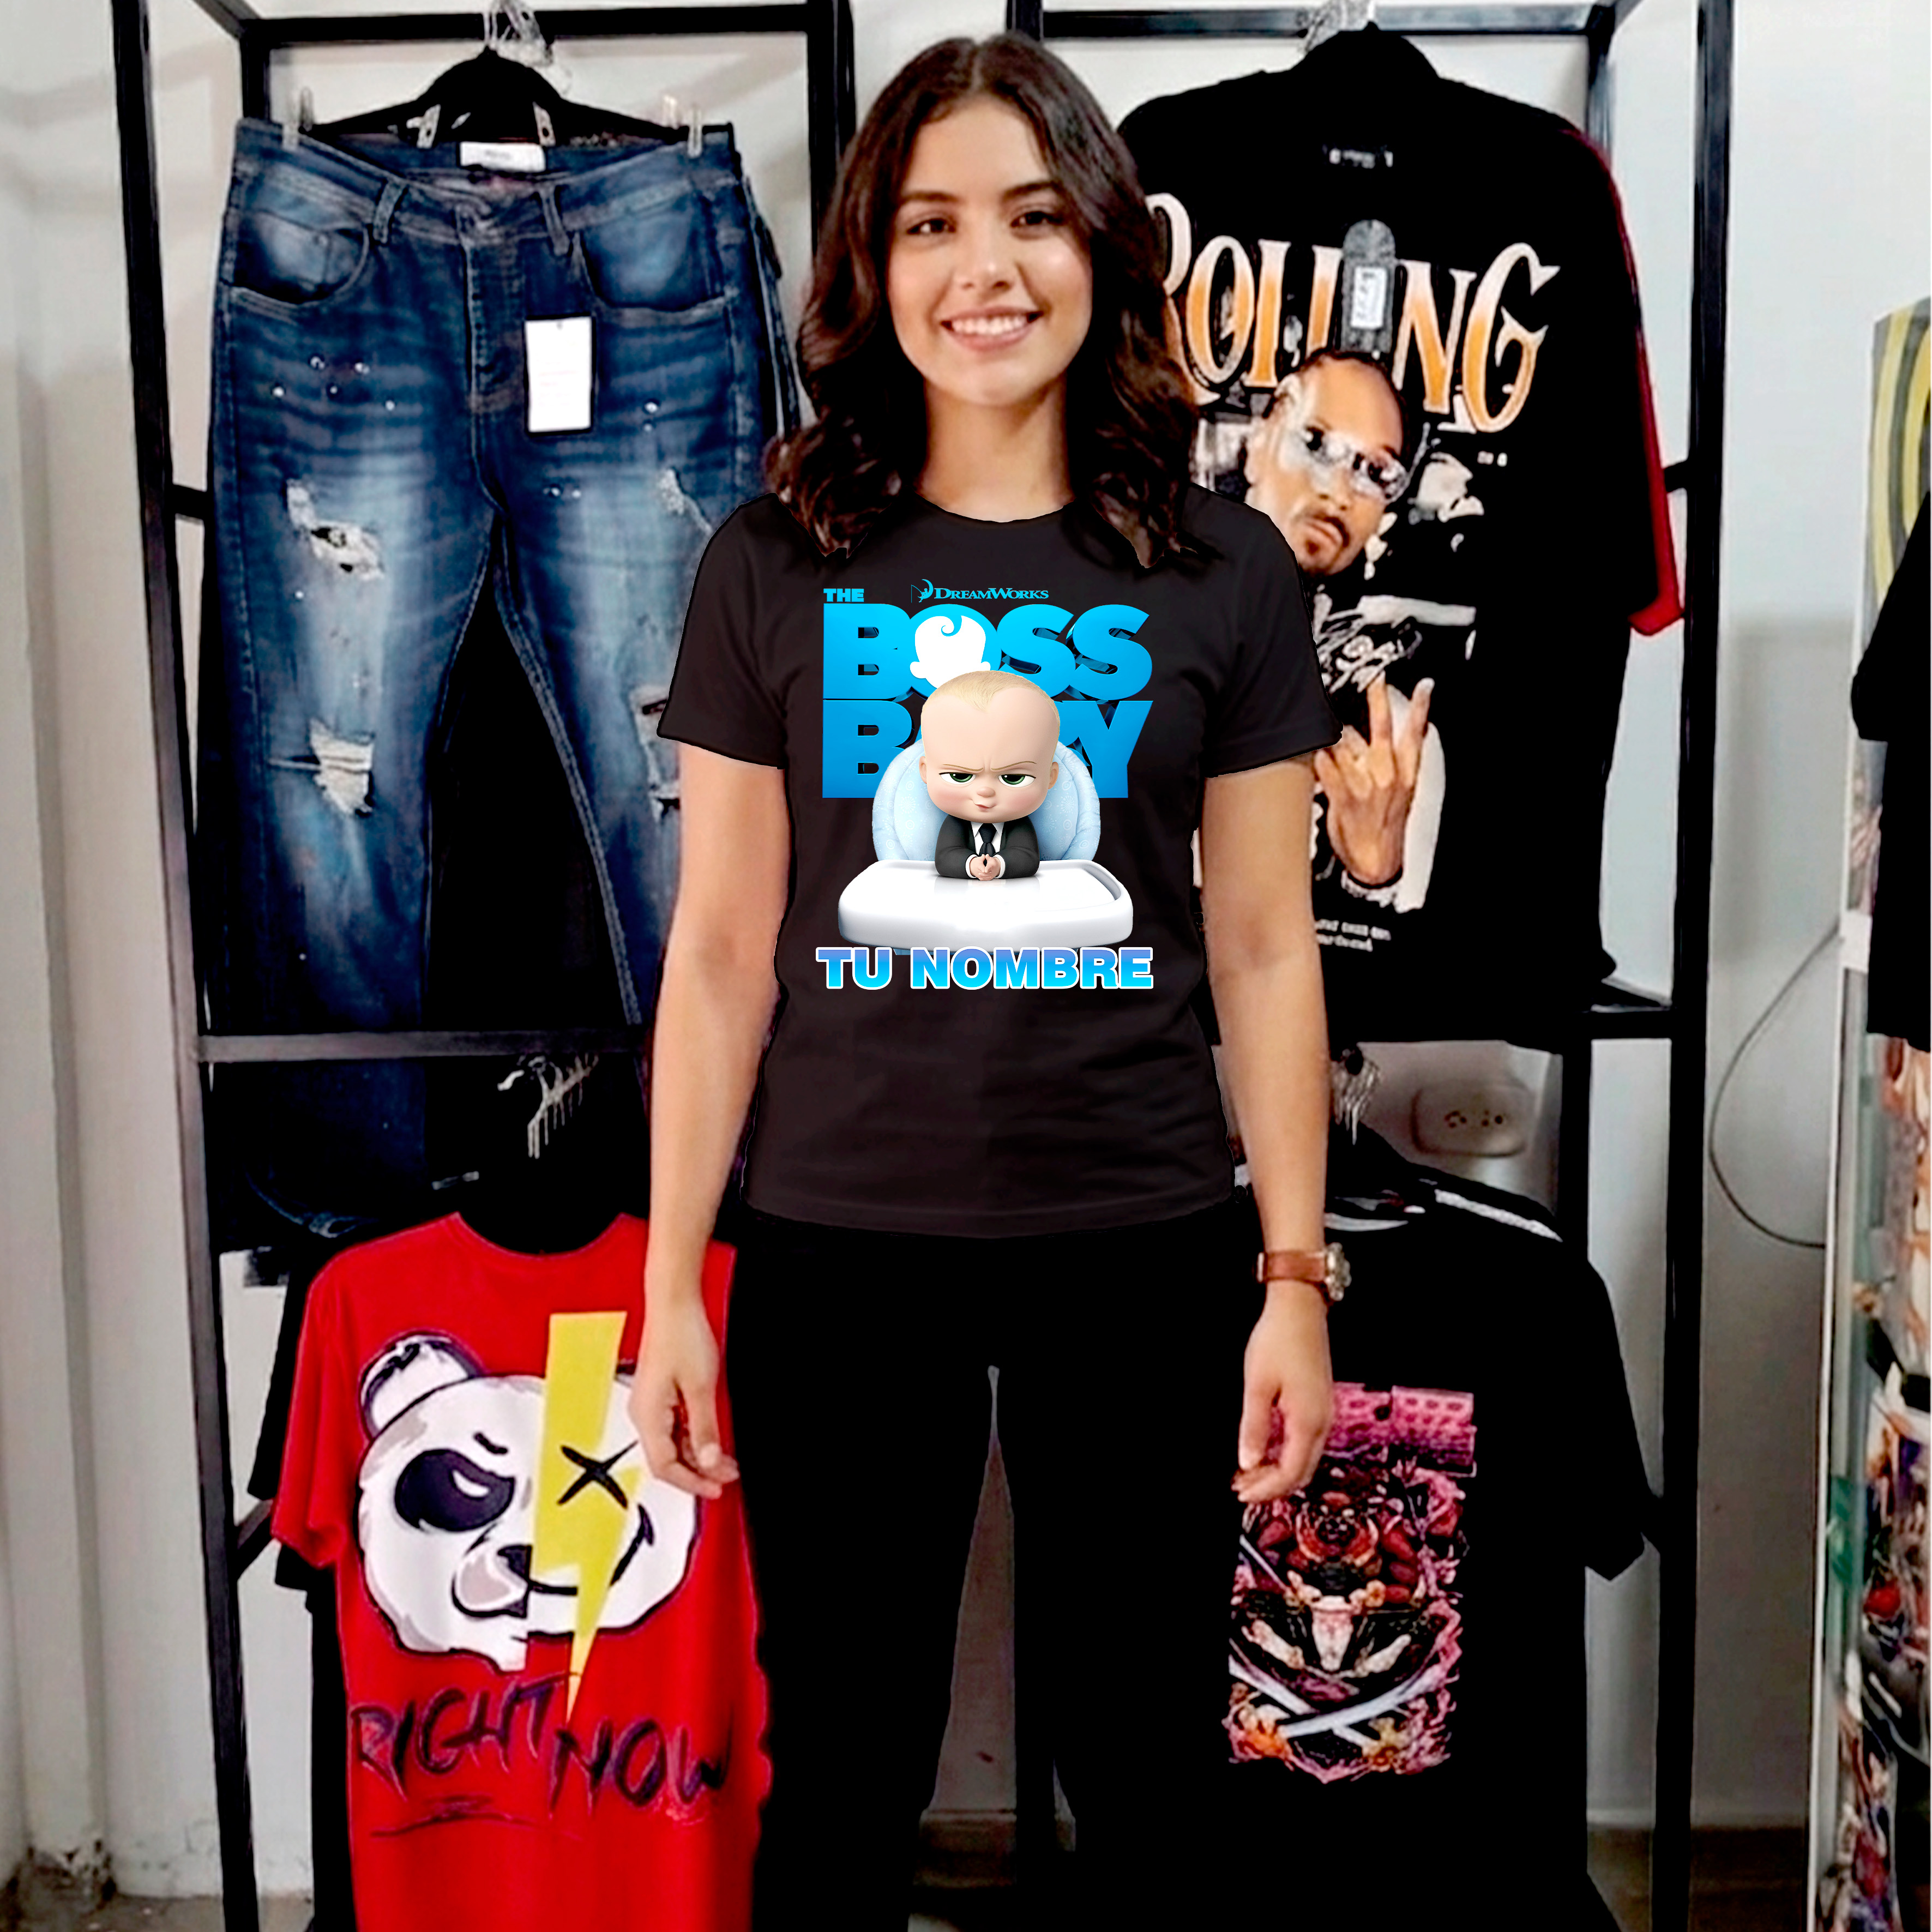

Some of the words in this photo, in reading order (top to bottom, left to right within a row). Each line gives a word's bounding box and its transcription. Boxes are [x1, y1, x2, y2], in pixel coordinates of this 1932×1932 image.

[823, 588, 864, 603] THE
[822, 603, 1153, 700] BOSS
[822, 700, 1153, 798] BY
[816, 947, 893, 990] TU
[910, 947, 1154, 990] NOMBRE
[350, 1672, 565, 1801] RIGHT
[547, 1716, 732, 1819] NOW
